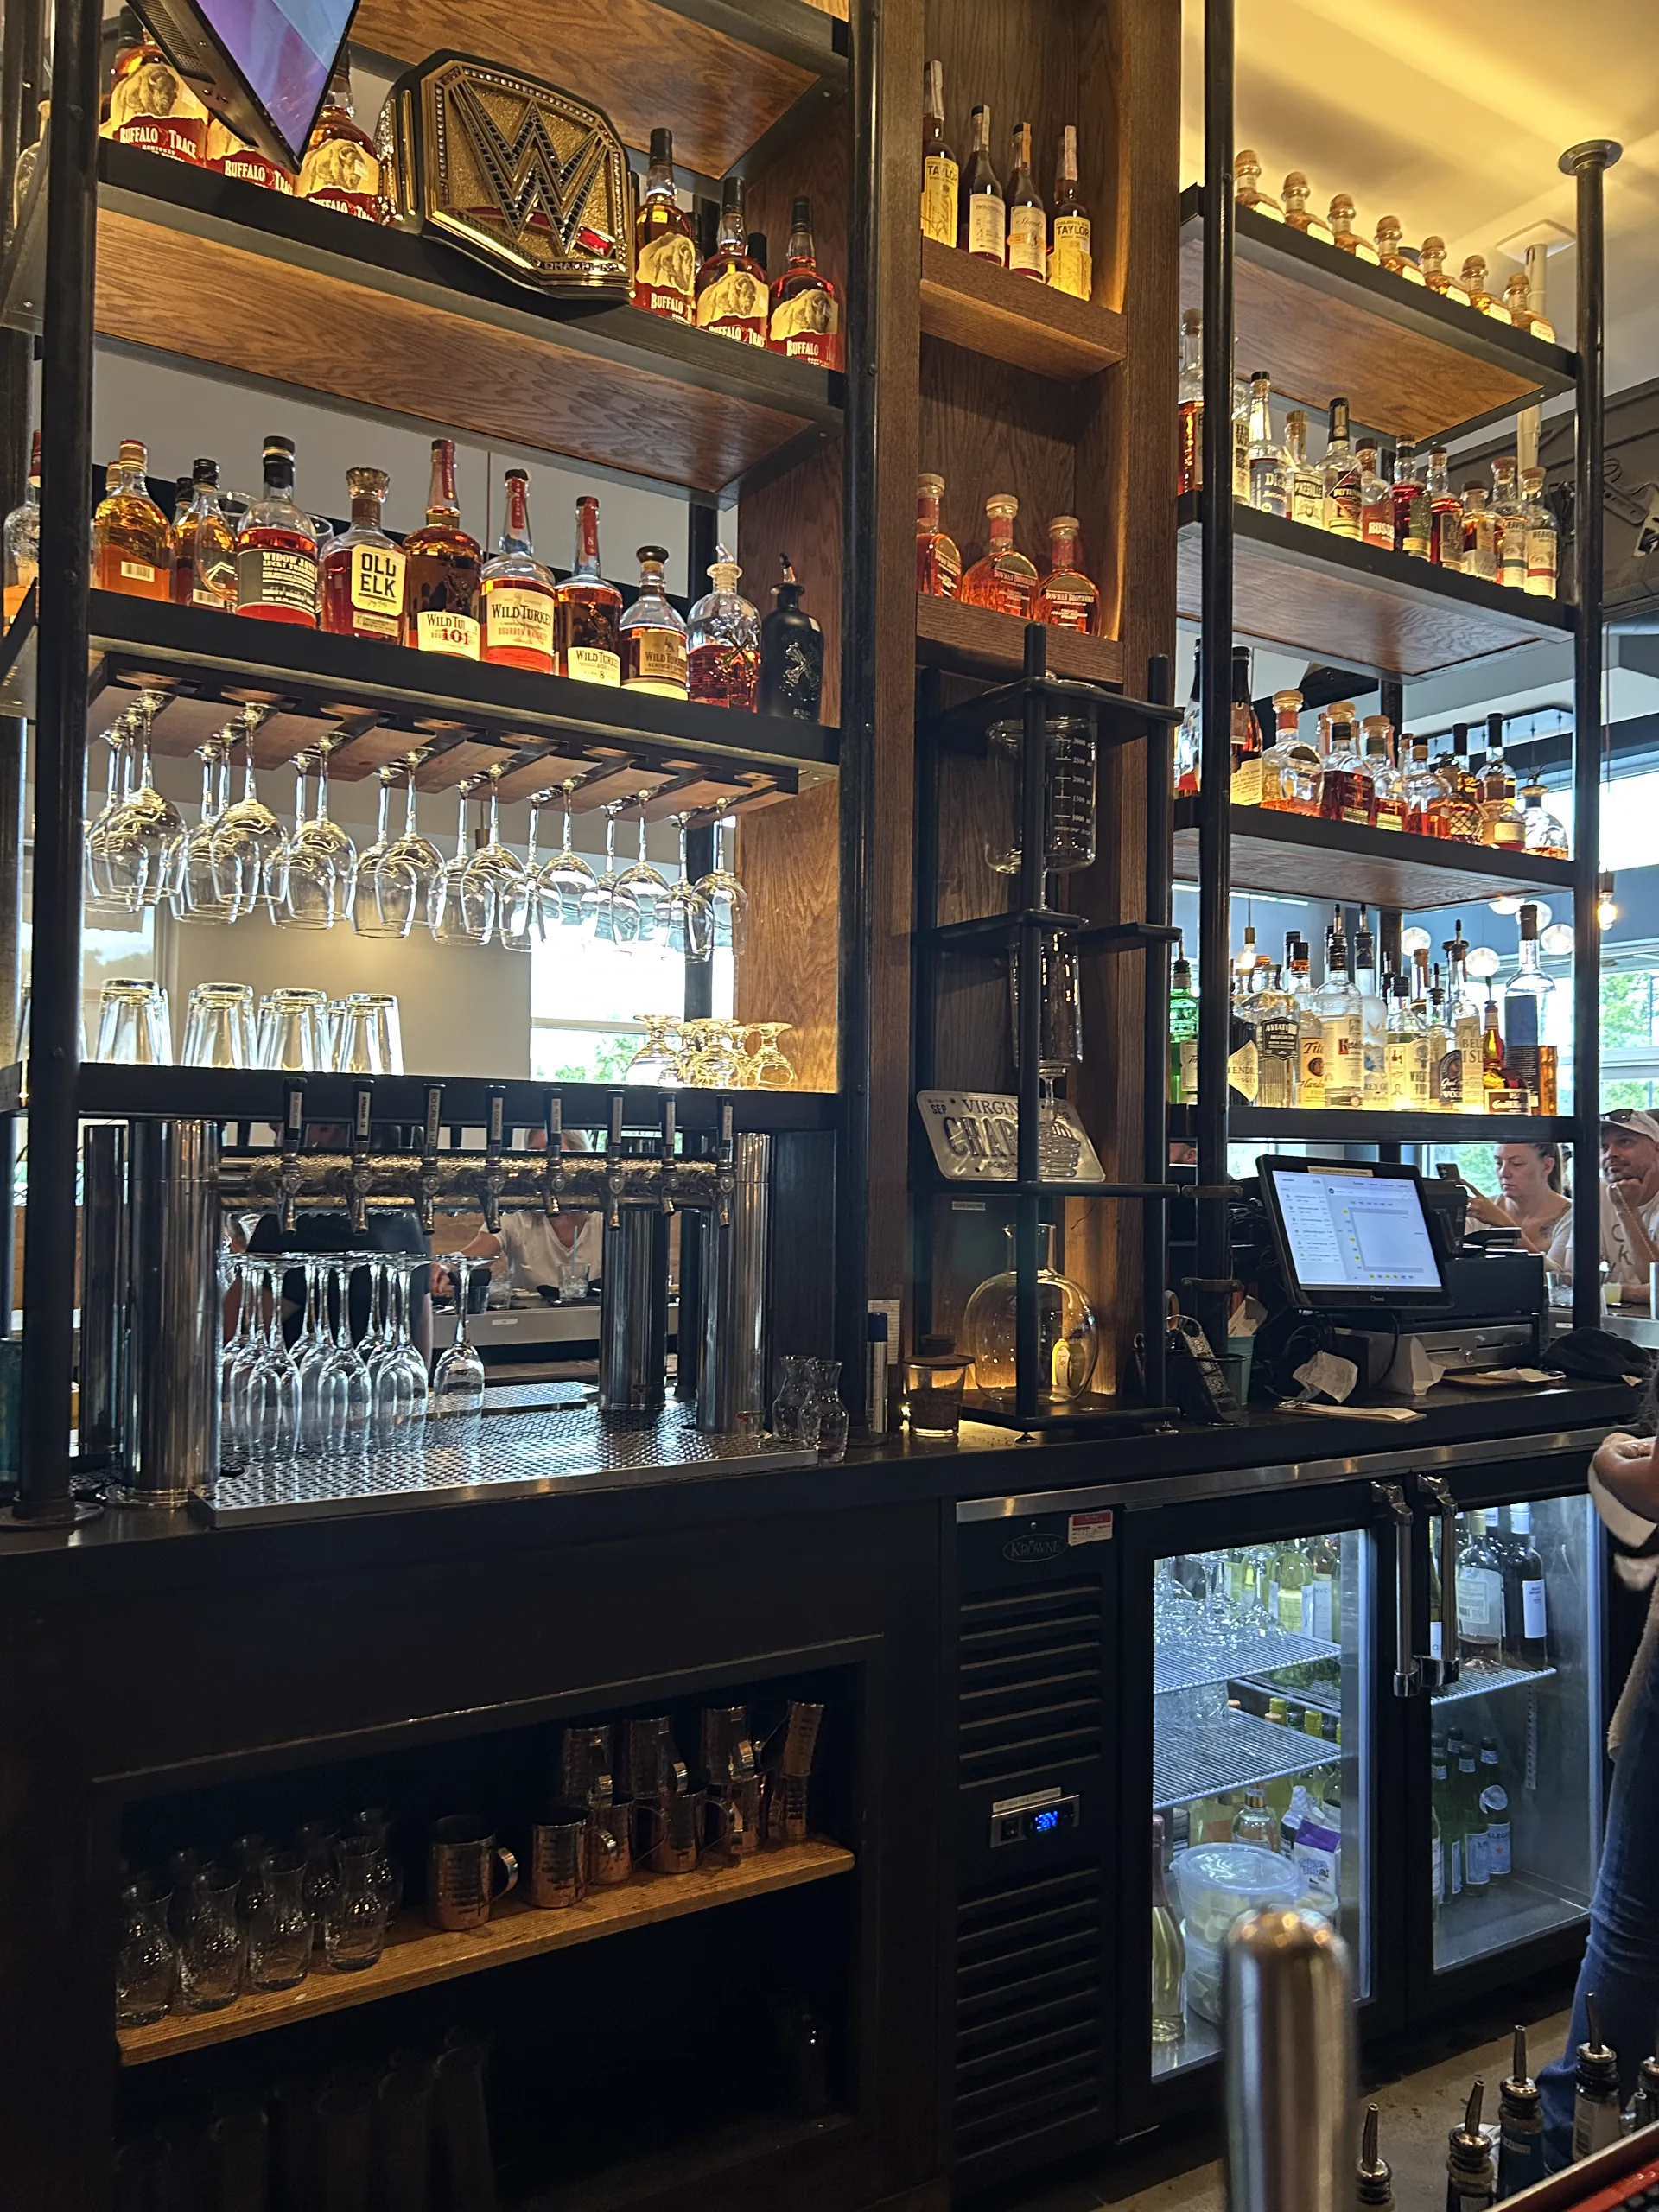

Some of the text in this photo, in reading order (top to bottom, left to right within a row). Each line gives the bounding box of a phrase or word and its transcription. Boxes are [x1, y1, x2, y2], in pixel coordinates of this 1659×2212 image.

[119, 127, 158, 144] BUFFALO
[168, 129, 198, 160] TRACE
[225, 159, 266, 183] BUFFALO
[1056, 225, 1089, 238] TAYLOR
[651, 292, 683, 313] BUFFALO
[786, 340, 819, 357] BUFFALO
[262, 551, 297, 564] WIDOW
[359, 572, 396, 598] ELK
[493, 603, 520, 619] WILD
[427, 613, 453, 627] WILD
[442, 627, 469, 645] 101
[575, 650, 598, 663] WILD
[645, 651, 666, 663] WILD
[599, 670, 605, 680] 8
[930, 1103, 947, 1115] SEP
[1010, 1538, 1062, 1557] KROWNE
